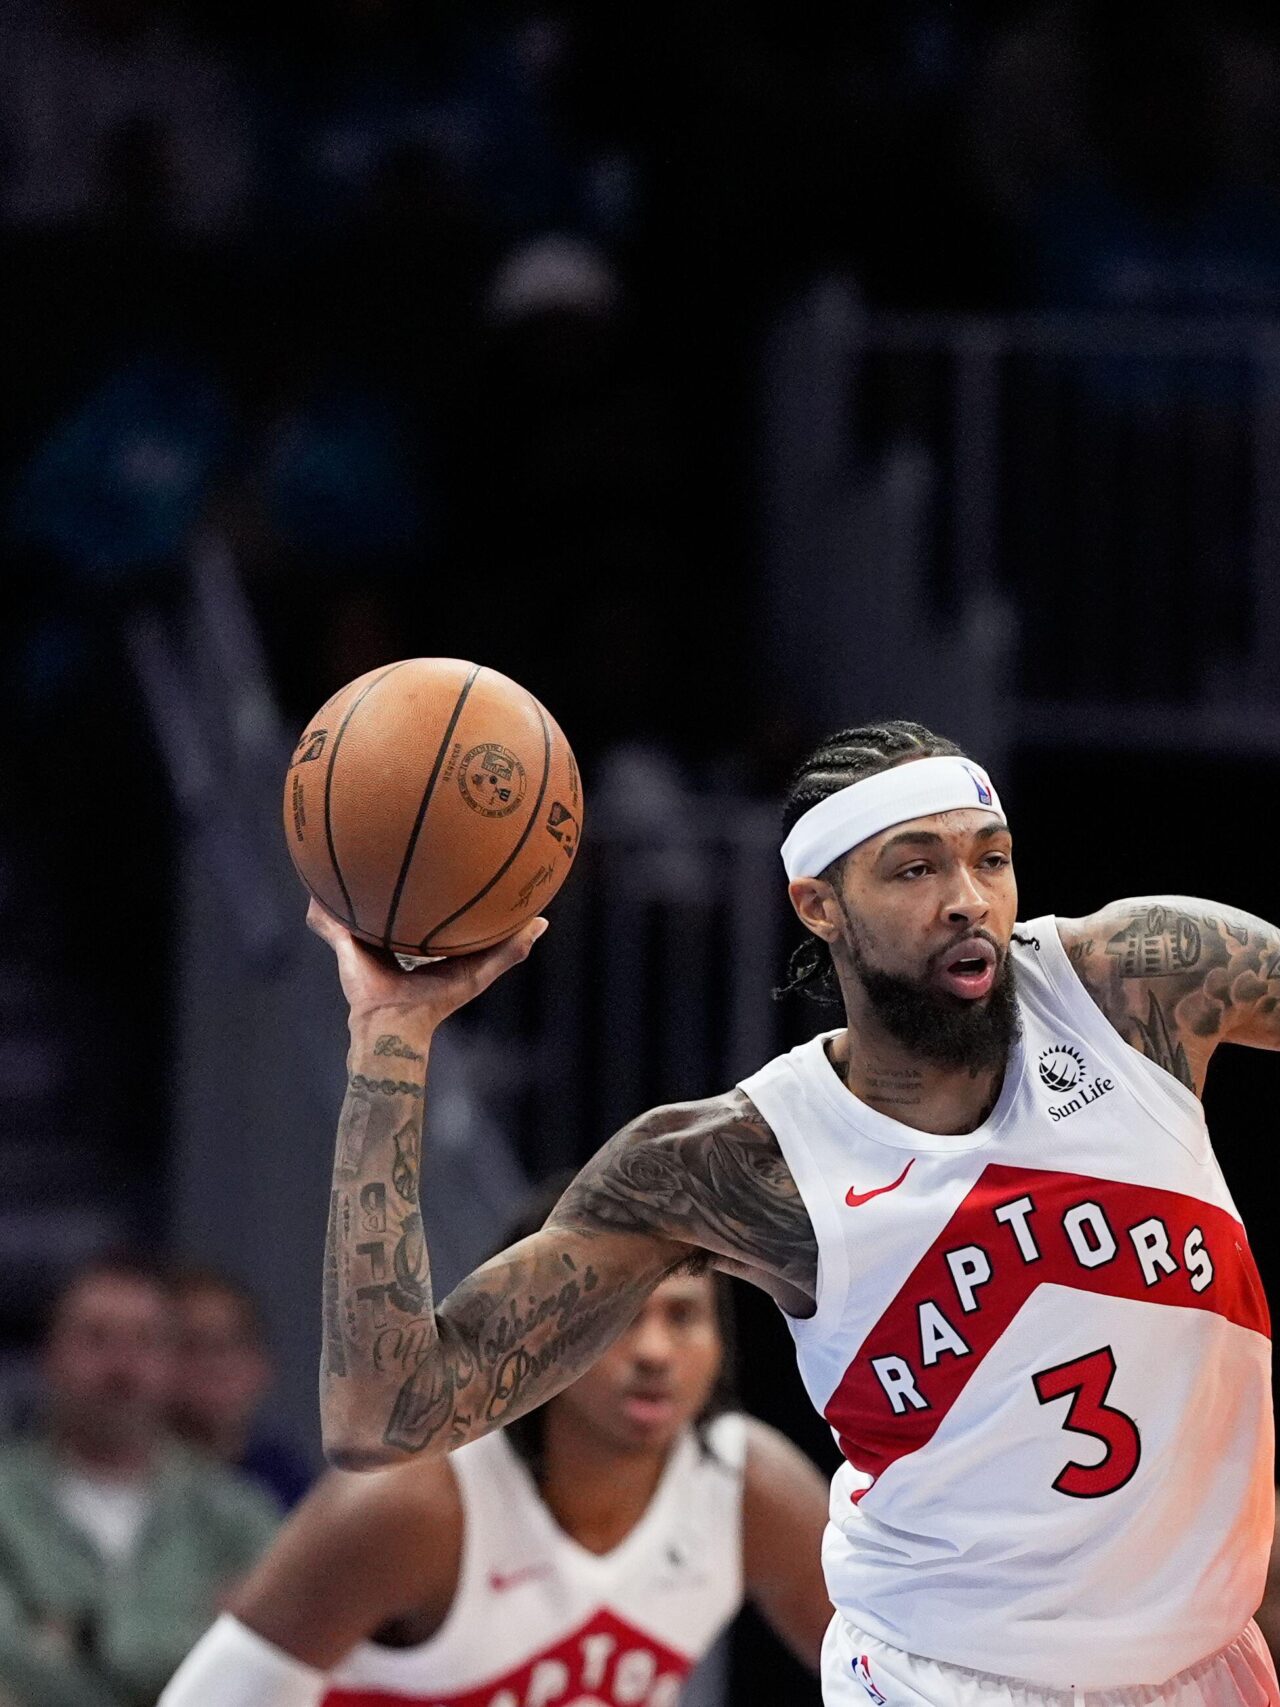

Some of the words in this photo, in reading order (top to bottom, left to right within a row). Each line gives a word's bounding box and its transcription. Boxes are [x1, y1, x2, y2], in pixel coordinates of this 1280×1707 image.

[1048, 1100, 1082, 1122] Sun
[1078, 1078, 1115, 1105] Life
[871, 1194, 1214, 1414] RAPTORS
[1031, 1345, 1142, 1499] 3
